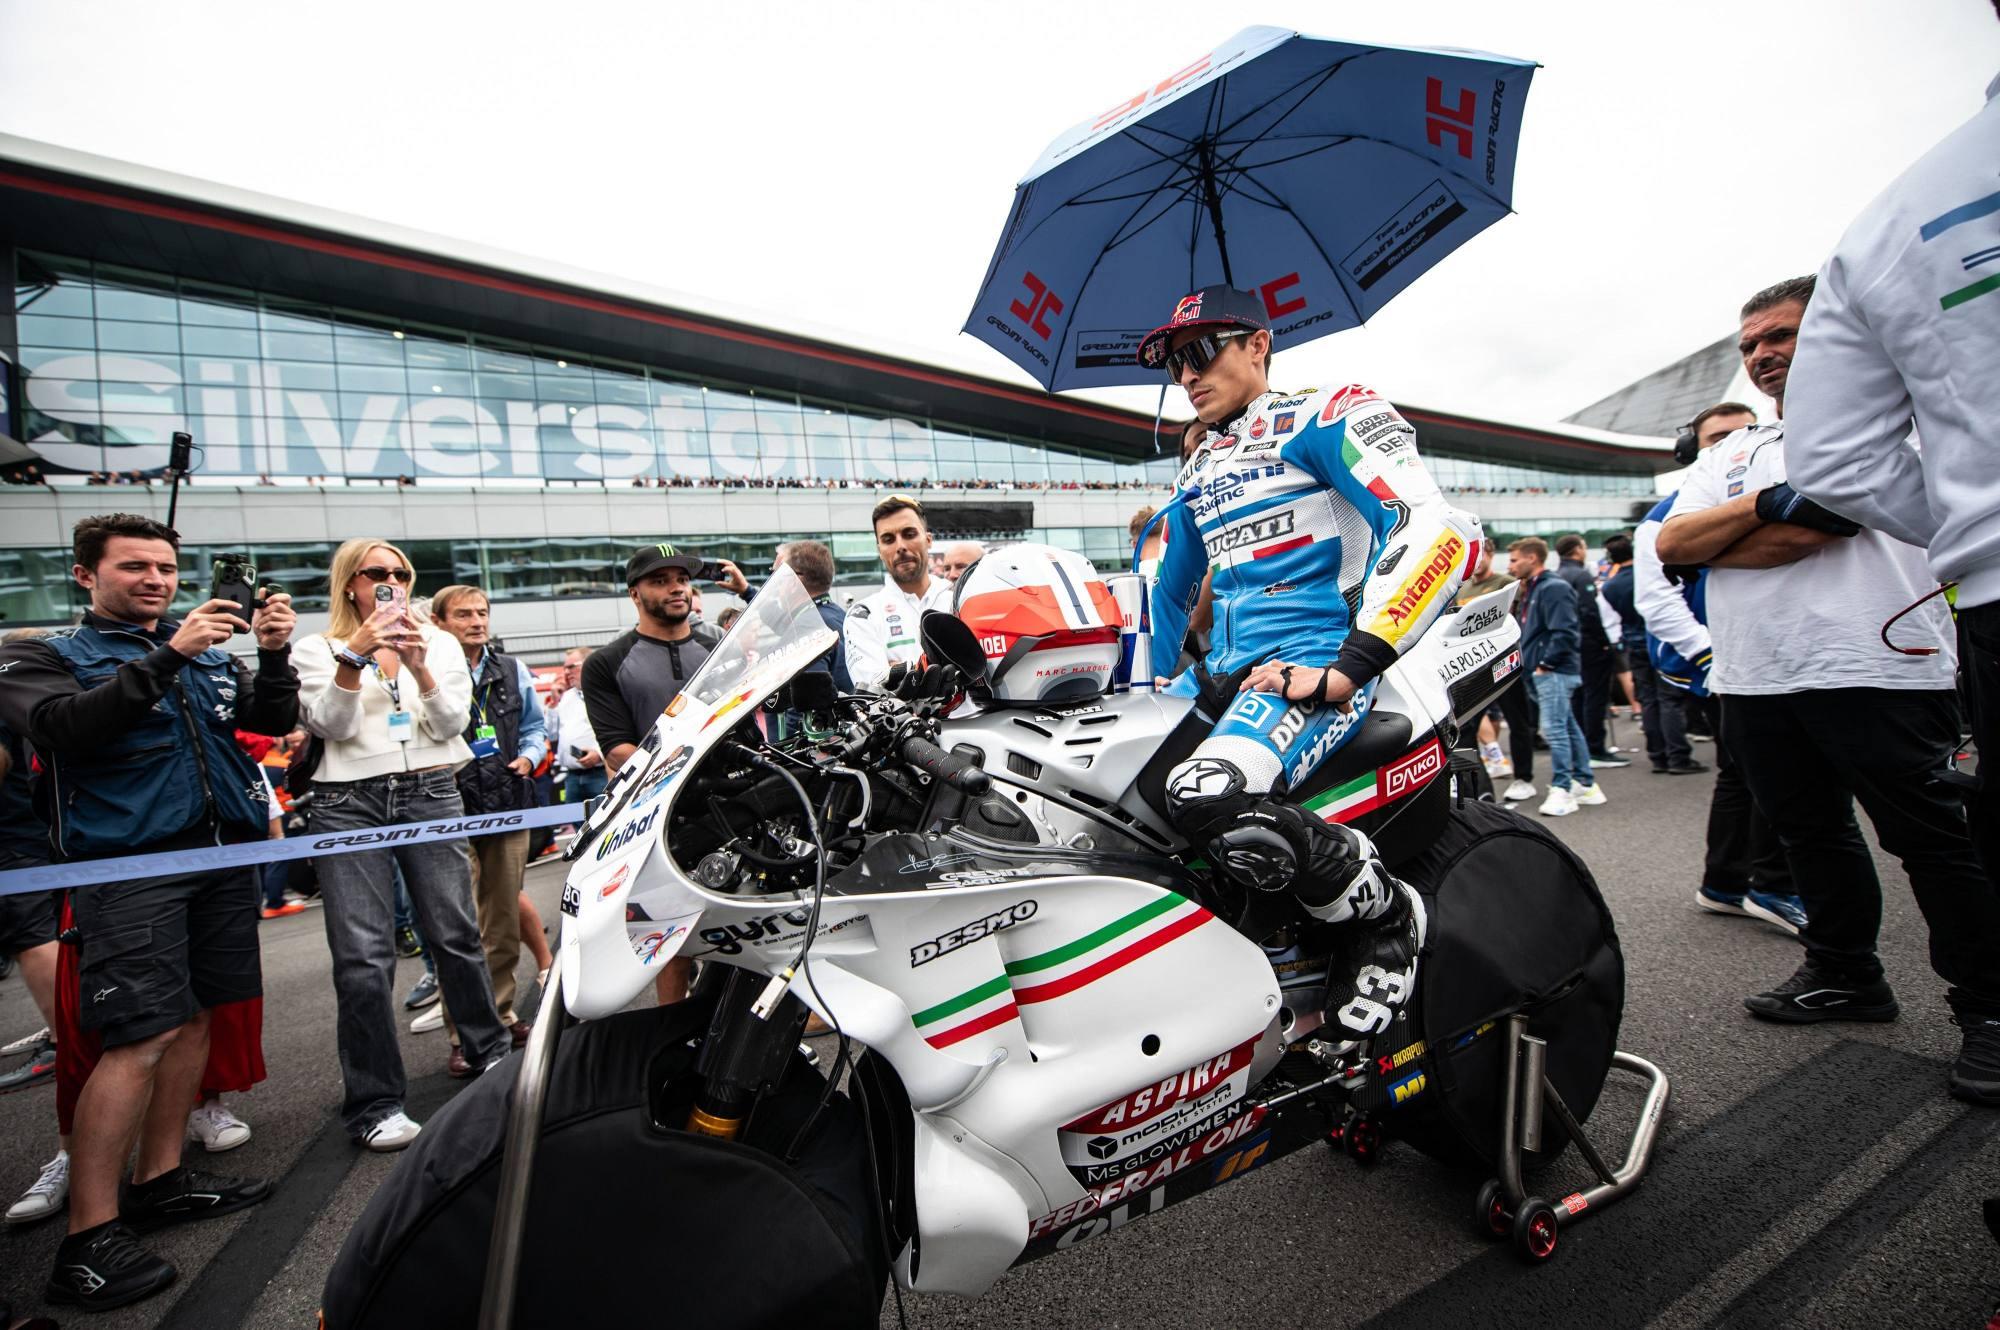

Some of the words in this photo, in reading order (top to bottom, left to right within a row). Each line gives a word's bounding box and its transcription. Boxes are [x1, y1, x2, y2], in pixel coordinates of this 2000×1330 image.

[1488, 78, 1506, 137] RACING
[1394, 194, 1447, 239] RACING
[1021, 339, 1050, 368] RACING
[25, 355, 936, 479] Silverstone
[1267, 397, 1308, 411] Unibat
[1353, 412, 1389, 434] BOLD
[1194, 486, 1245, 519] RACING
[1199, 462, 1285, 503] RESINI
[1388, 537, 1462, 628] Antangin
[1460, 611, 1504, 637] GLOBAL
[1474, 605, 1498, 624] AUS
[1036, 668, 1066, 677] MARC
[1391, 754, 1436, 788] DAIKO
[313, 827, 421, 850] GRESINI
[426, 814, 523, 834] RACING
[597, 804, 660, 861] Unibat
[1237, 811, 1254, 819] one
[910, 899, 1038, 969] DESMO
[1337, 964, 1407, 1034] 93
[1161, 1117, 1188, 1134] CASE
[1194, 1091, 1233, 1118] SYSTEM
[1029, 1146, 1194, 1240] FEDERAL
[1202, 1111, 1257, 1155] OIL
[1087, 1163, 1120, 1183] MS
[1124, 1131, 1186, 1171] GLOW
